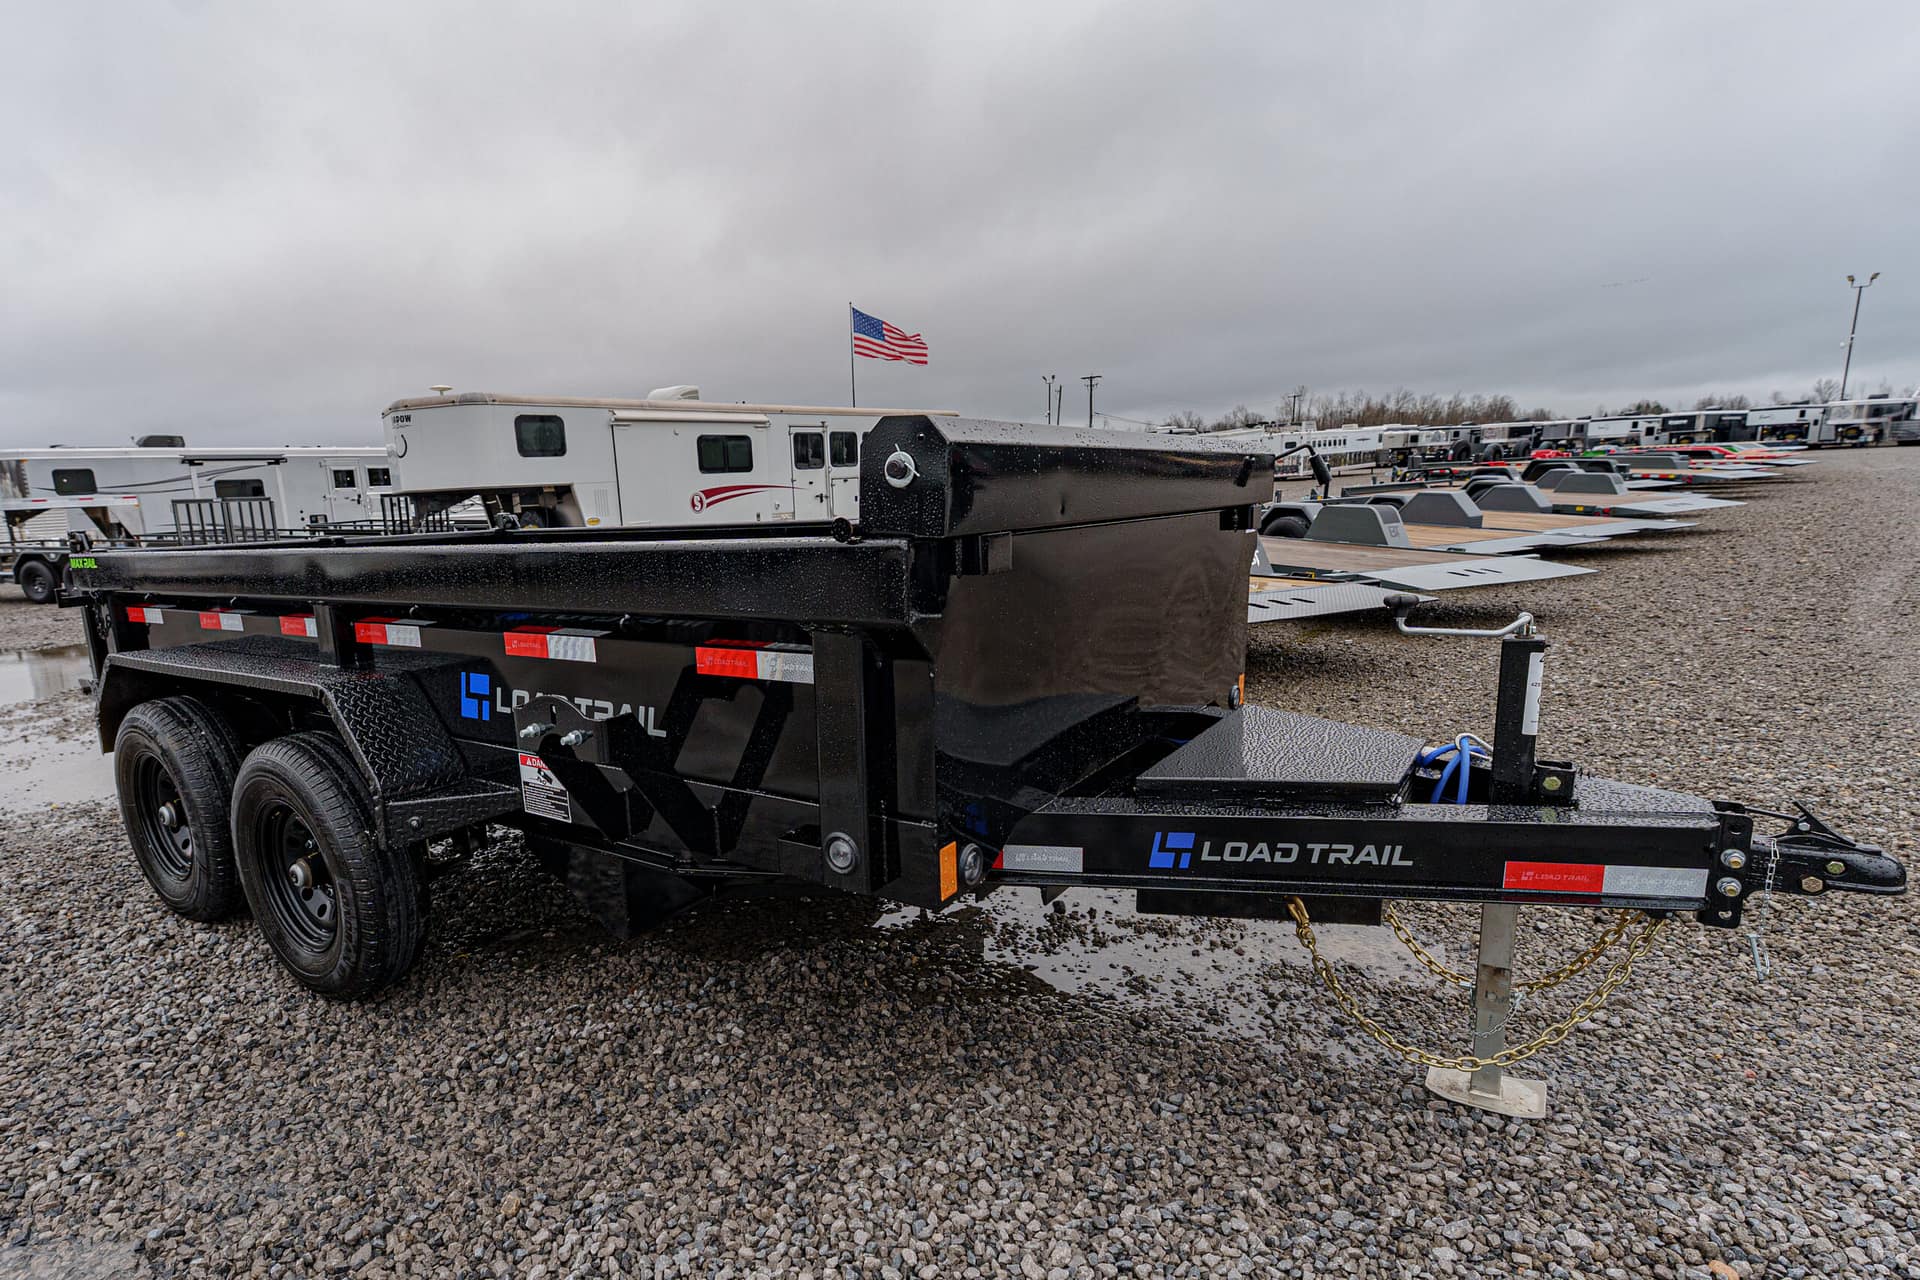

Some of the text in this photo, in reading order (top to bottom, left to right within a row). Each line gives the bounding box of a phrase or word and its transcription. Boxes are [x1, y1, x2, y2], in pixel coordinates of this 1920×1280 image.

[496, 687, 569, 715] LO
[1201, 841, 1414, 866] LOAD TRAIL
